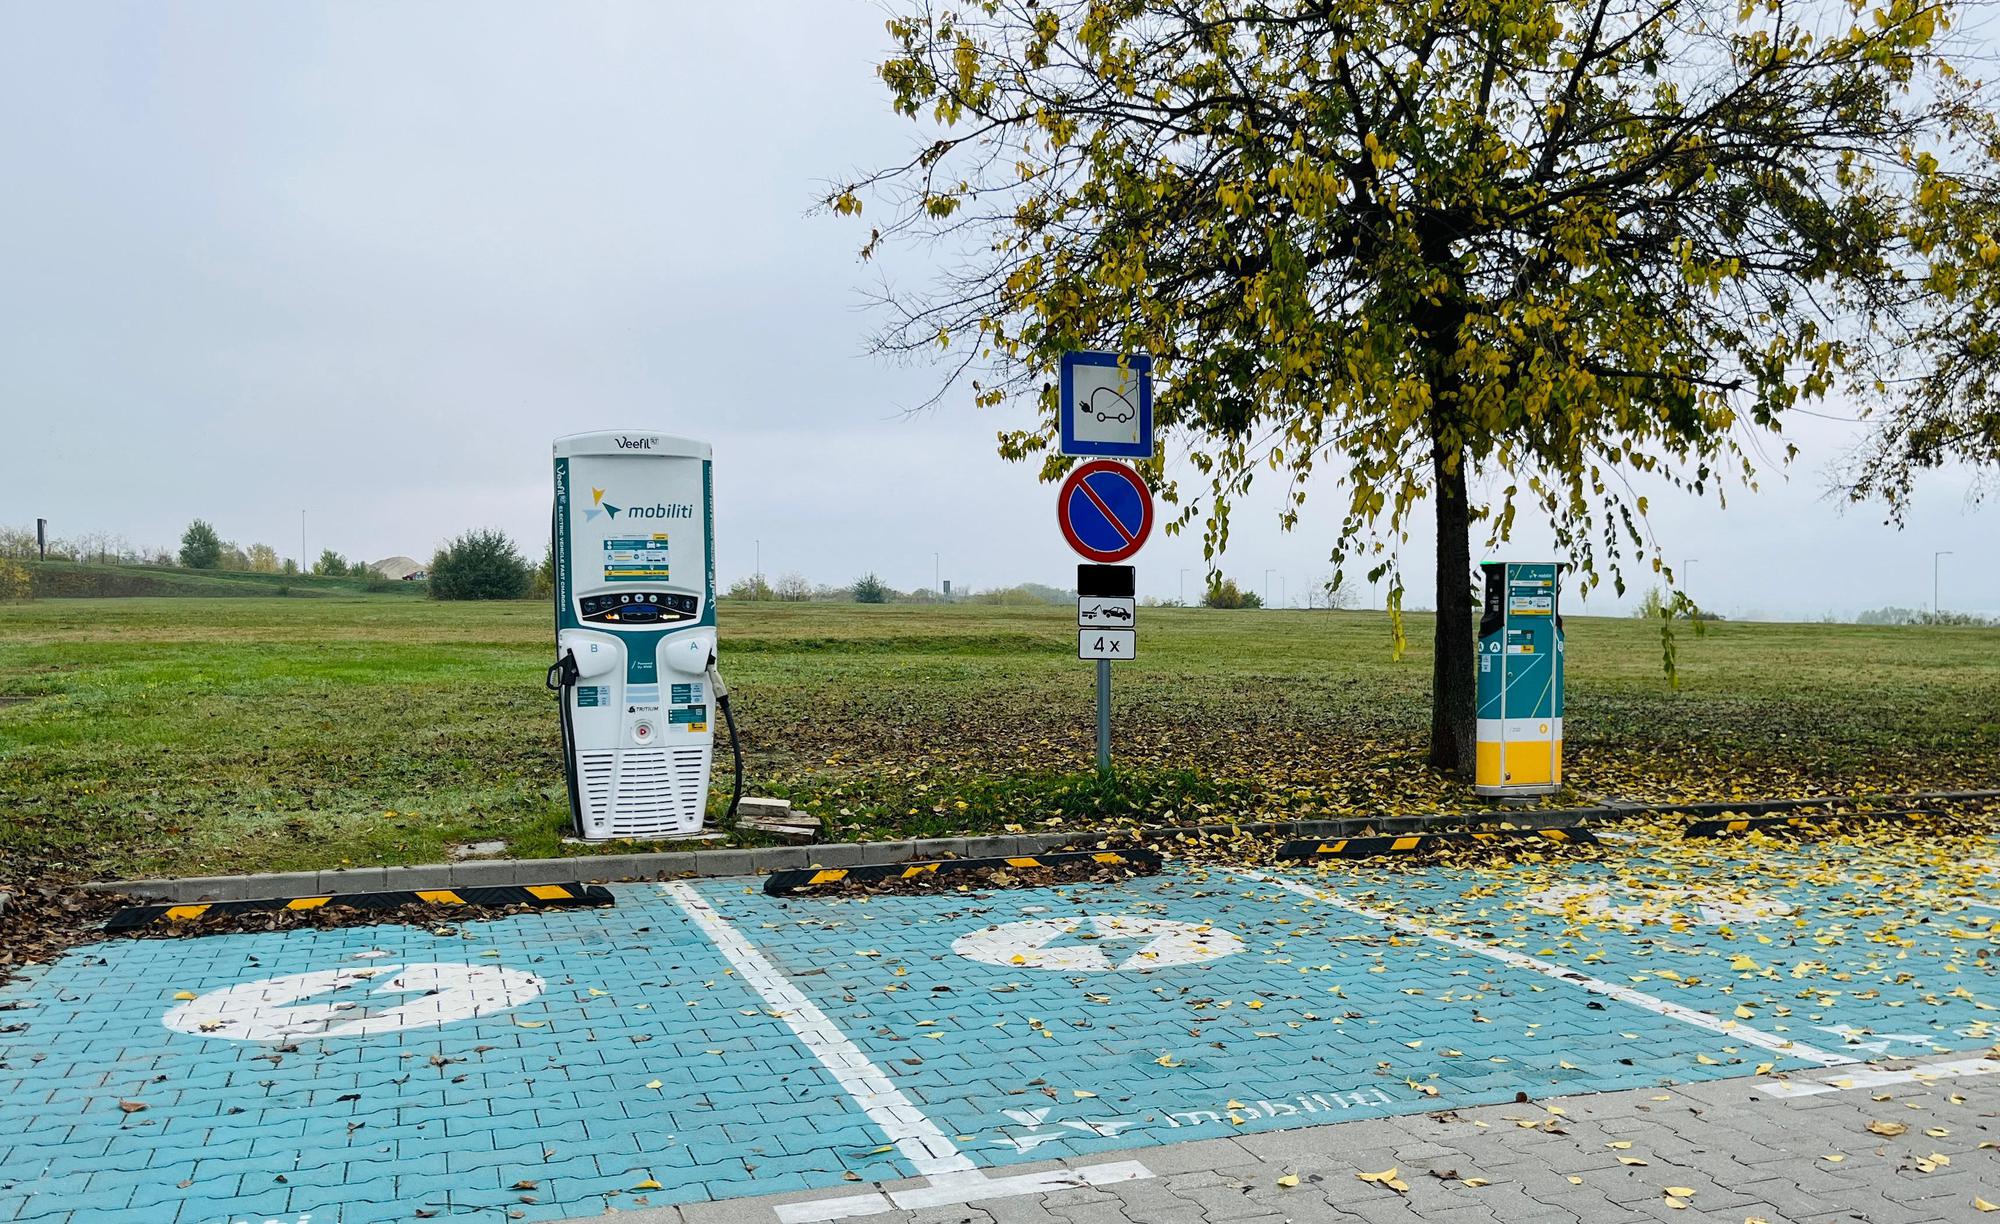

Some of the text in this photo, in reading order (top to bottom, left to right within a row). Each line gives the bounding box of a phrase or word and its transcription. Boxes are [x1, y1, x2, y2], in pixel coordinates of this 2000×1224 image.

[614, 436, 651, 449] Veefil
[556, 464, 566, 496] Veefil
[628, 503, 693, 518] mobiliti
[591, 644, 598, 652] B
[690, 642, 698, 650] A
[1093, 636, 1104, 652] 4
